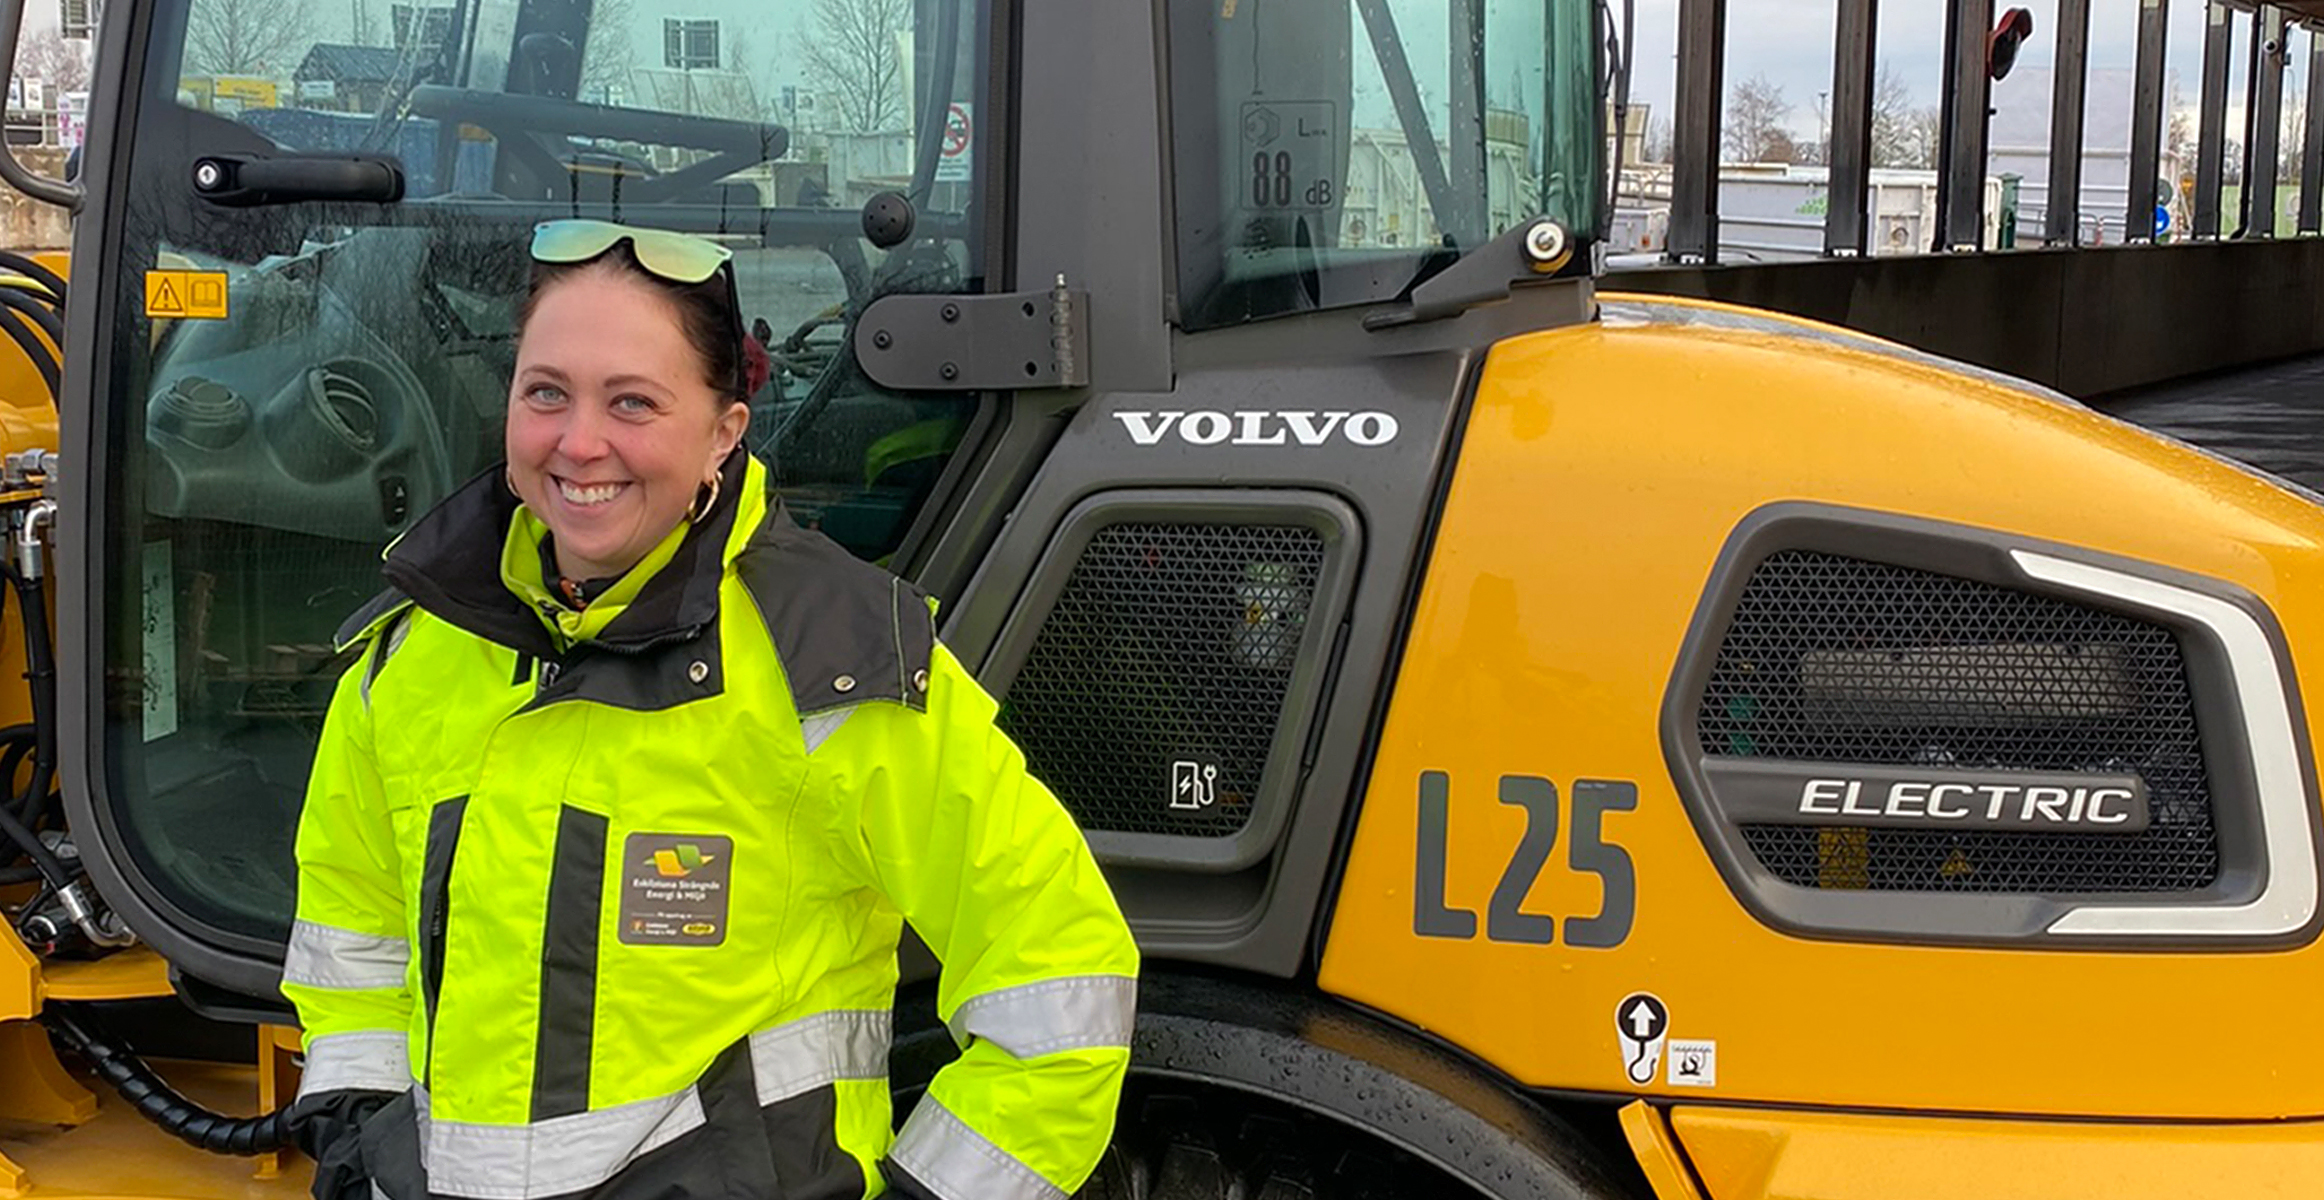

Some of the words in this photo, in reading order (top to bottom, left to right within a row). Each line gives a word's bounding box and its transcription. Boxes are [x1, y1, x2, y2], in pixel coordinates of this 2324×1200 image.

[1253, 151, 1291, 207] 88
[1305, 178, 1332, 205] dB
[1113, 411, 1398, 445] VOLVO
[1799, 779, 2133, 823] ELECTRIC
[1414, 769, 1638, 949] L25
